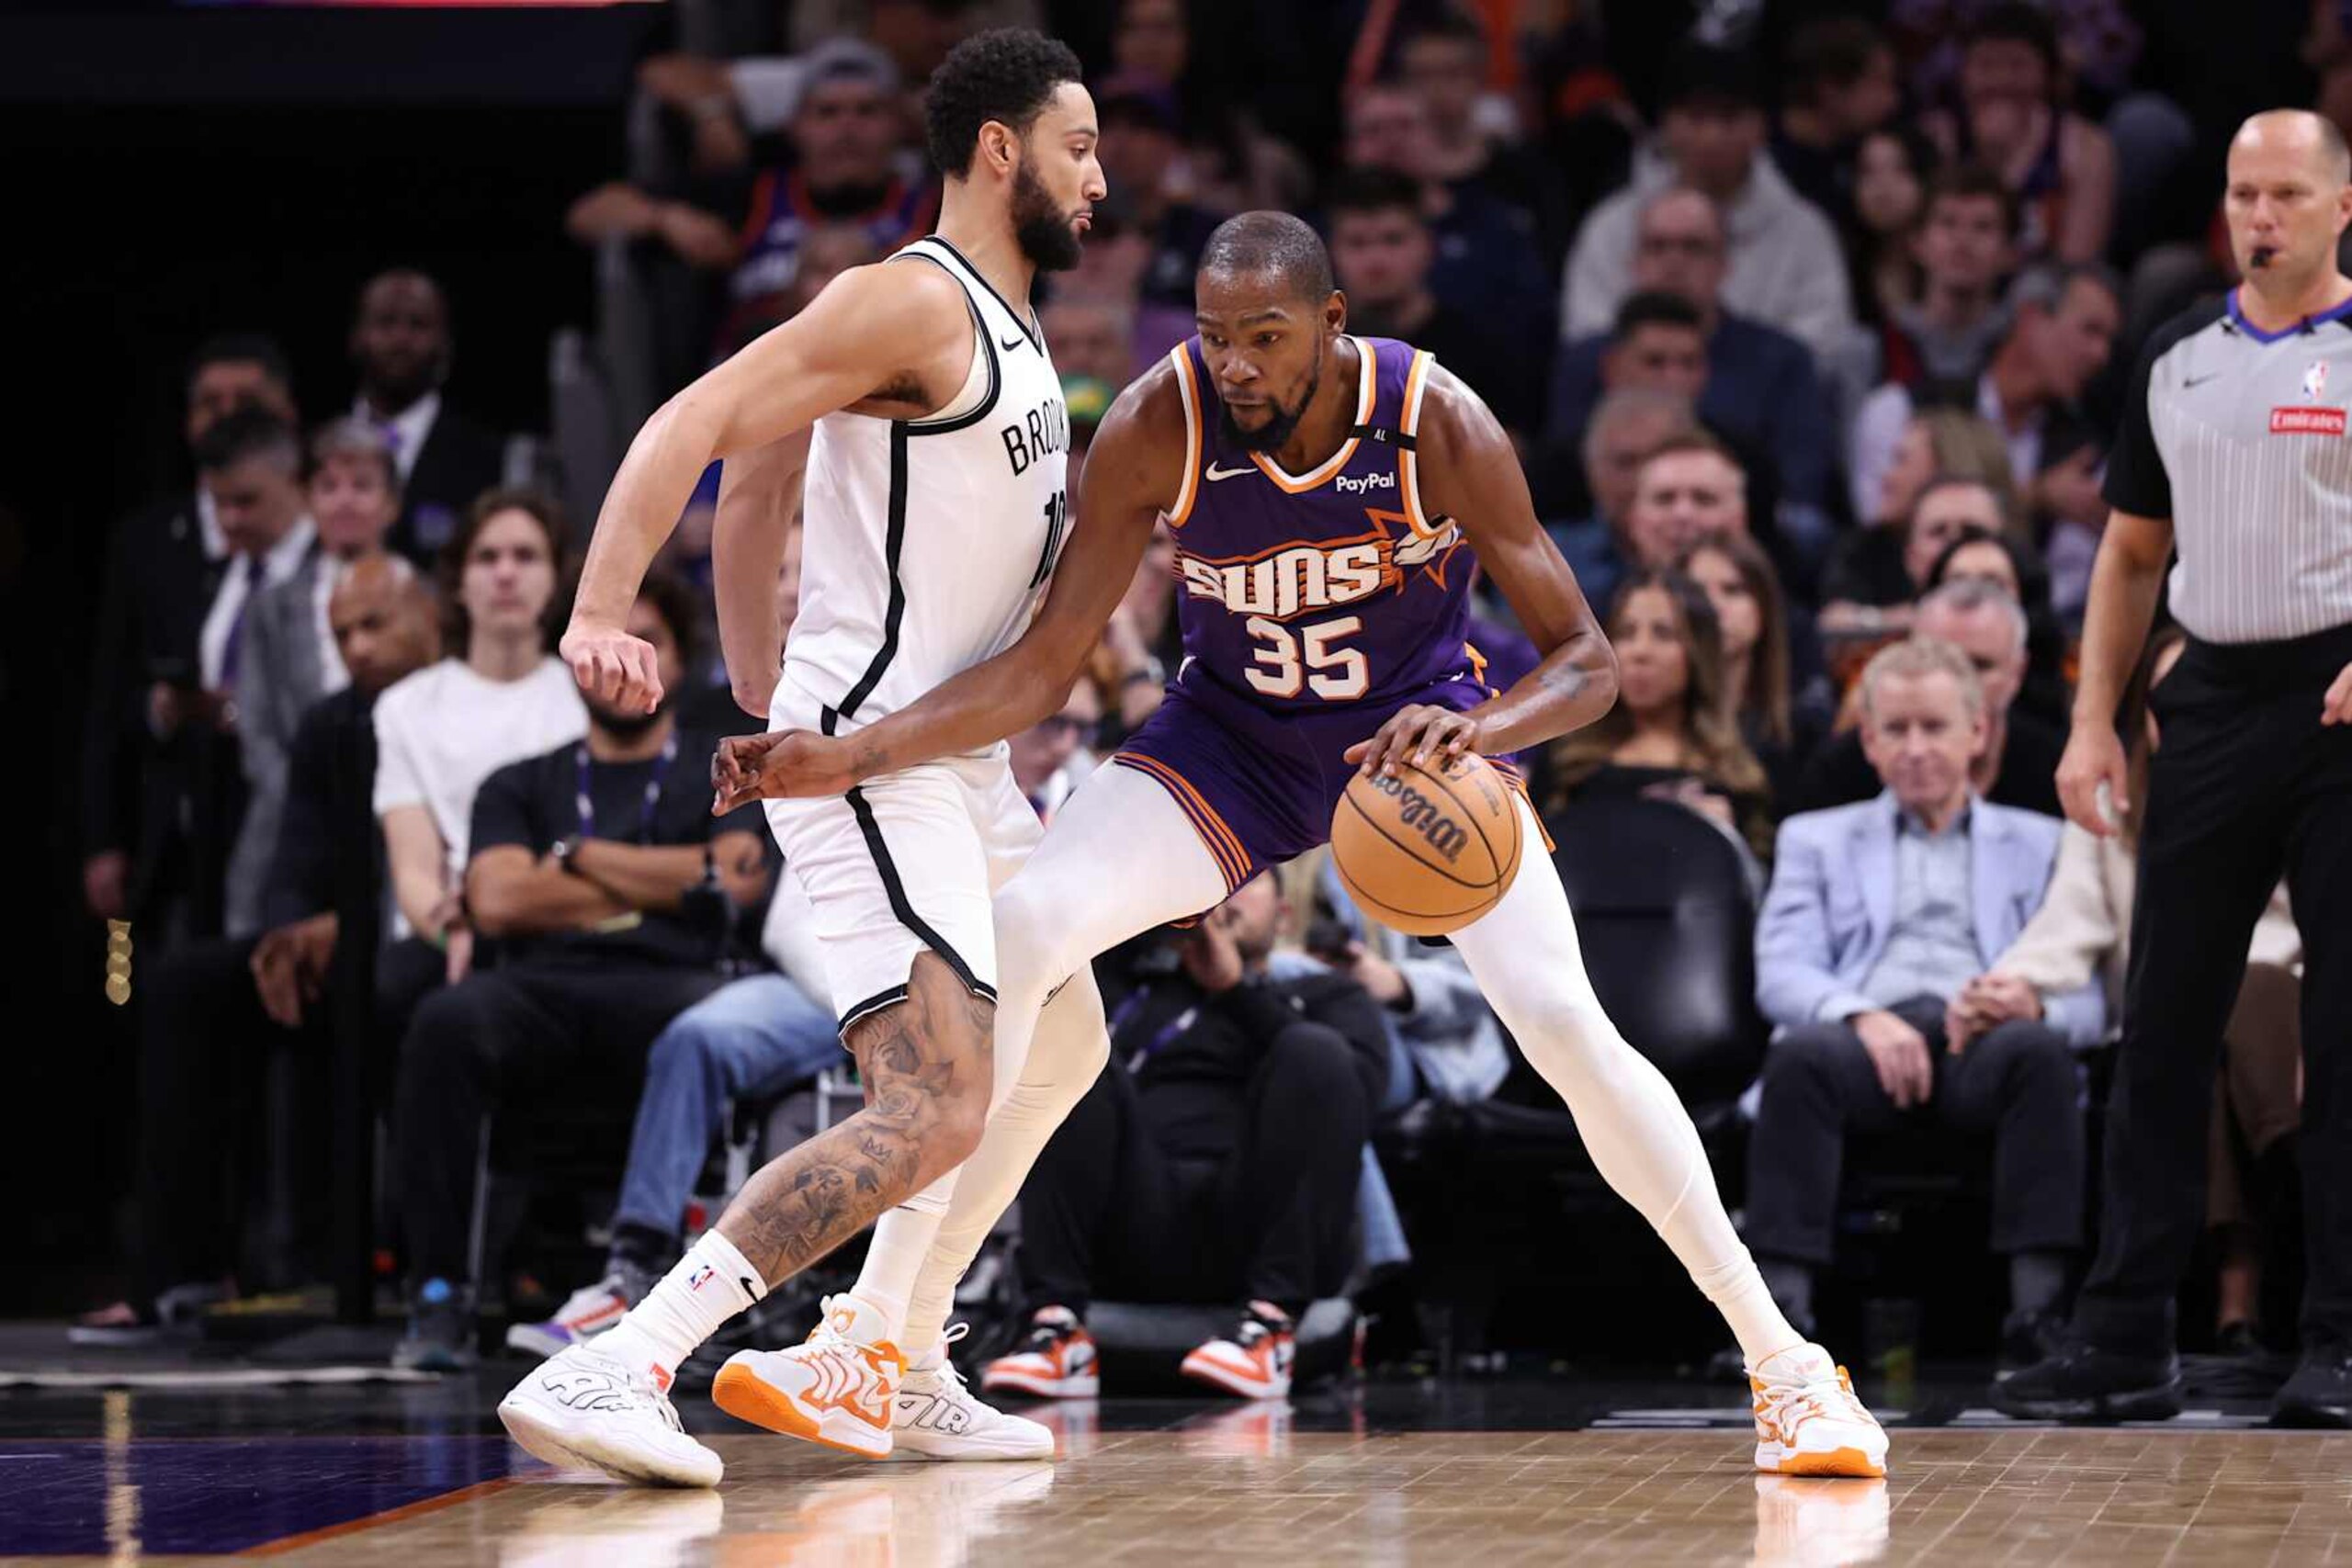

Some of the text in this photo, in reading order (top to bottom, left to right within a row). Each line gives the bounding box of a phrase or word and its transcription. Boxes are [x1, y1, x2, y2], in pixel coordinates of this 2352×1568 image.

[1374, 428, 1386, 441] AL
[1336, 471, 1395, 494] PayPal
[1028, 490, 1067, 590] 10
[1243, 615, 1370, 701] 35
